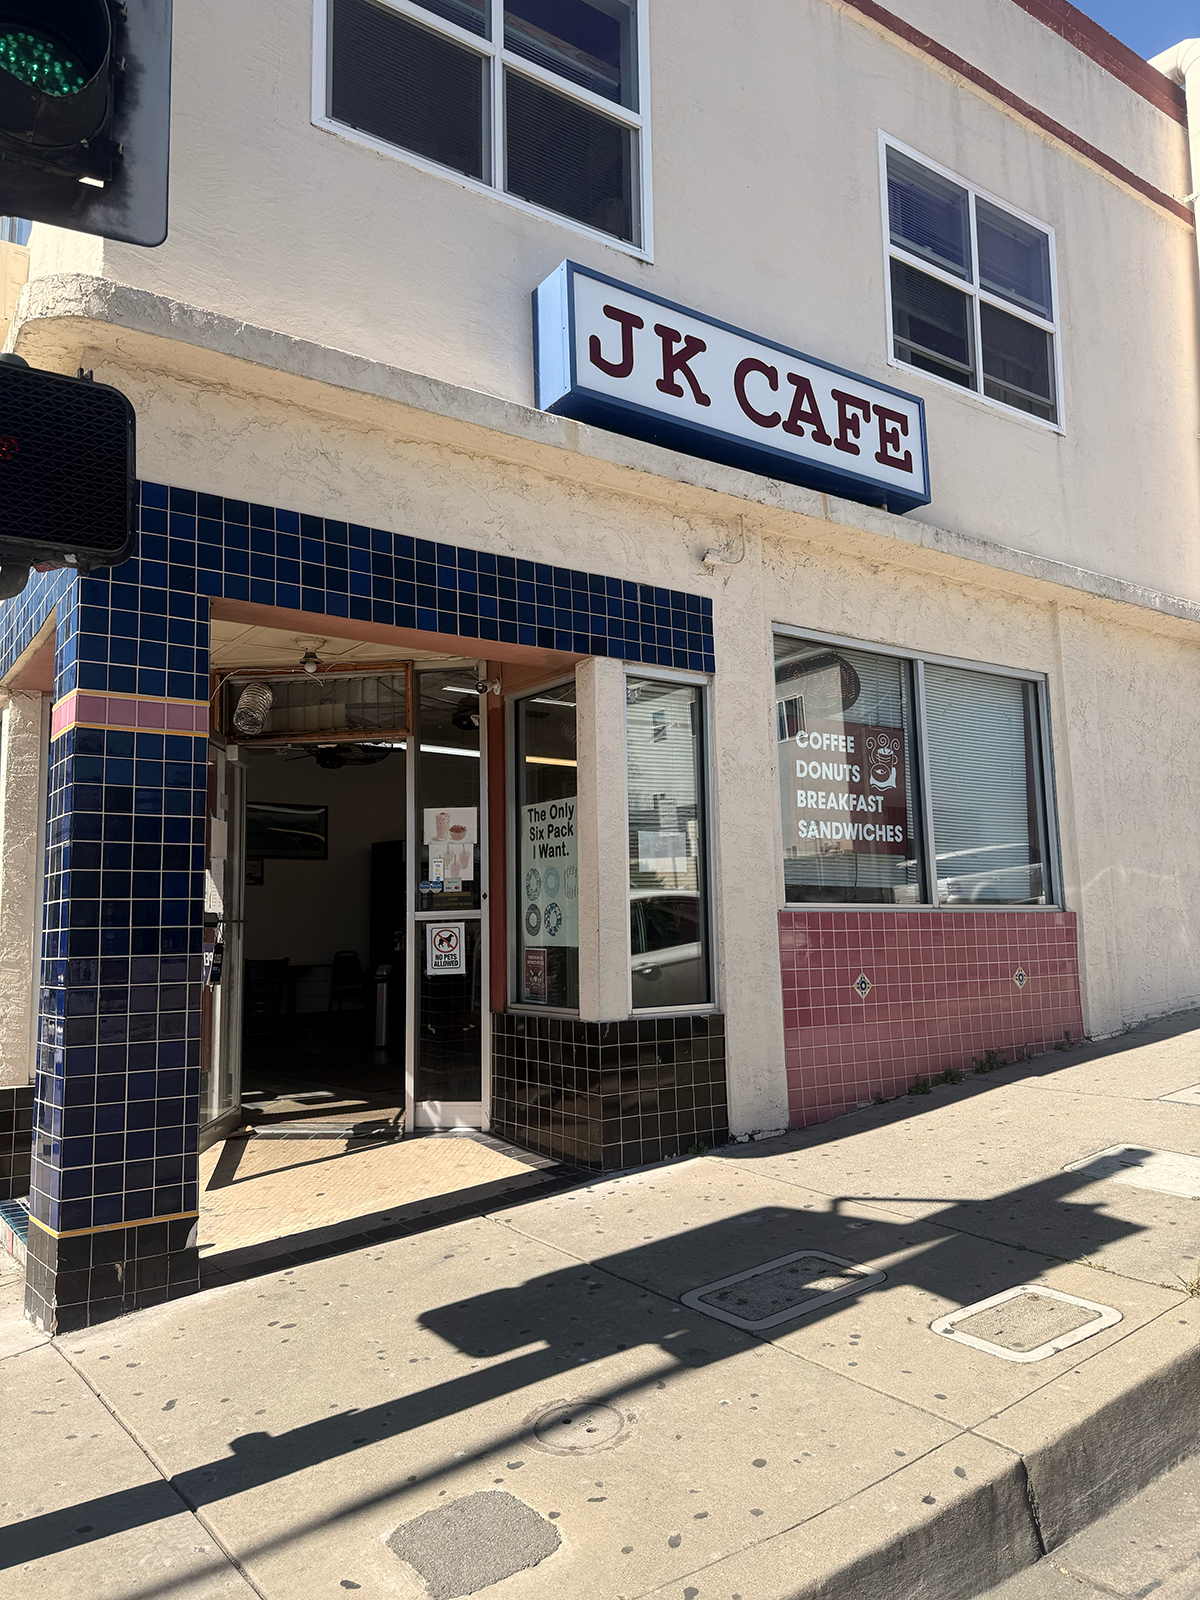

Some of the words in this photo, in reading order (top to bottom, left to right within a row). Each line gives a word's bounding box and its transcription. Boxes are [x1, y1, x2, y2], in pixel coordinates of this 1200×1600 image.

[589, 304, 711, 407] JK
[733, 357, 913, 473] CAFE
[795, 730, 855, 753] COFFEE
[796, 759, 860, 782] DONUTS
[527, 808, 547, 823] The
[549, 802, 574, 821] Only
[797, 789, 884, 813] BREAKFAST
[529, 826, 544, 841] Six
[547, 821, 574, 839] Pack
[798, 819, 903, 843] SANDWICHES
[533, 845, 536, 860] I
[539, 841, 569, 859] Want.
